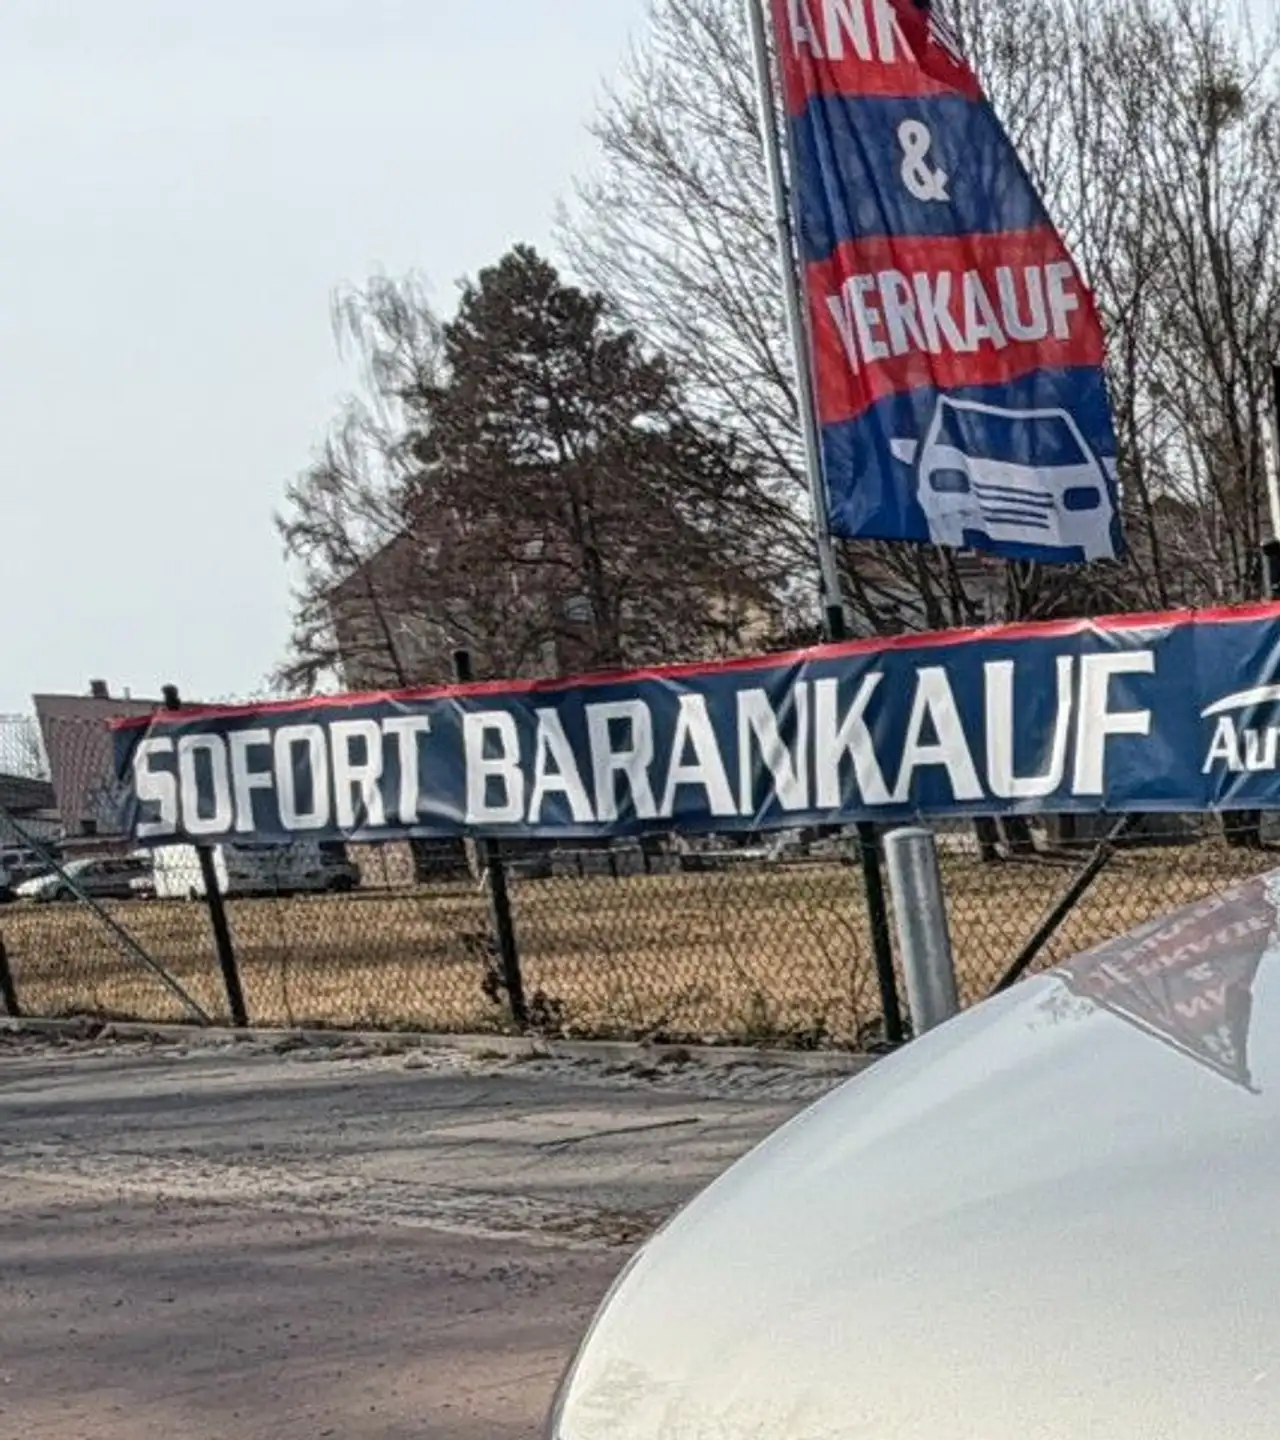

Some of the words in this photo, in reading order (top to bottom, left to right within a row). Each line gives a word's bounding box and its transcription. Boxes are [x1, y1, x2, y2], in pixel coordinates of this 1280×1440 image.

[897, 119, 950, 201] &
[827, 261, 1081, 376] VERKAUF
[132, 714, 430, 837] SOFORT
[464, 650, 1155, 826] BARANKAUF
